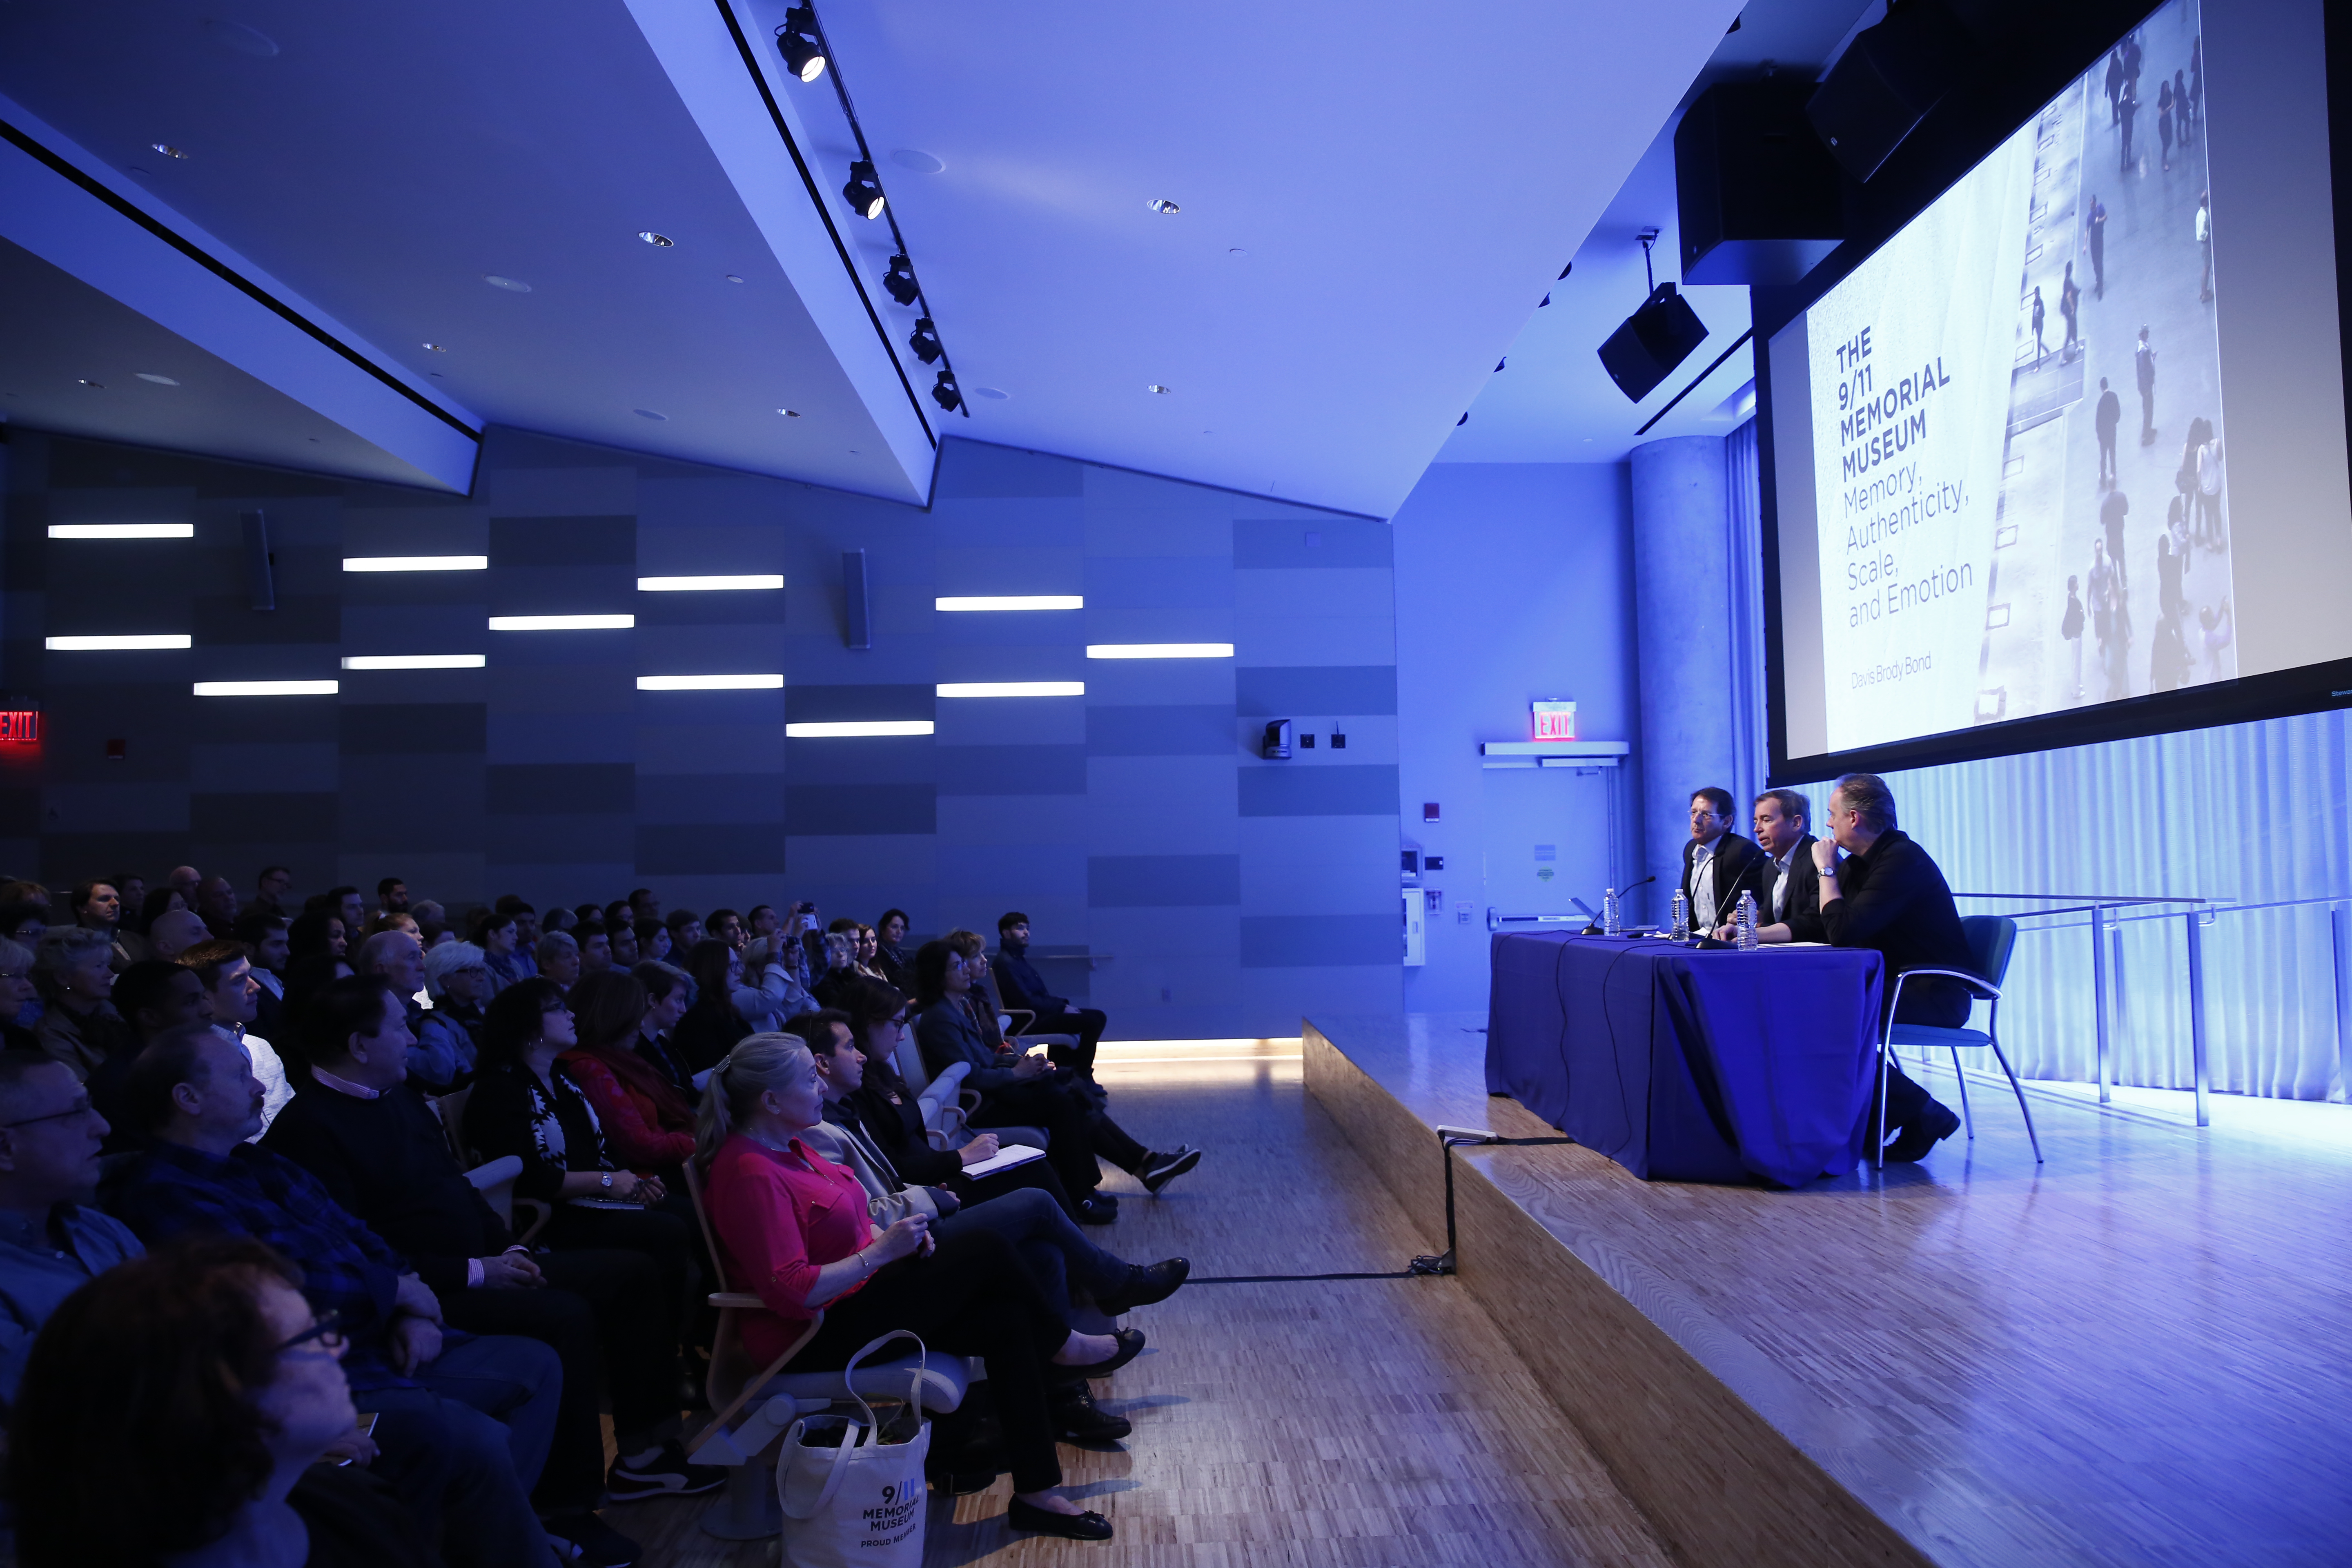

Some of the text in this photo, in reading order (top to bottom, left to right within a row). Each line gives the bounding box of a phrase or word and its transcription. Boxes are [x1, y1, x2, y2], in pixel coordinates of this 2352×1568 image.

[1836, 325, 1871, 374] THE
[1838, 364, 1871, 410] 9/11
[1841, 356, 1950, 447] MEMORIAL
[1843, 409, 1926, 482] MUSEUM
[1844, 461, 1922, 519] Memory,
[1846, 479, 1969, 555] Authenticity,
[1848, 550, 1898, 590] Scale,
[1850, 563, 1972, 628] and Emotion
[1851, 650, 1931, 689] Davis Brody Bond
[0, 712, 33, 738] EXIT
[1540, 711, 1571, 735] EXIT
[863, 1495, 919, 1519] MEMORIAL
[882, 1478, 915, 1505] 9/11
[861, 1523, 916, 1548] PROUD MEMBER
[870, 1508, 914, 1532] MUSEUM
